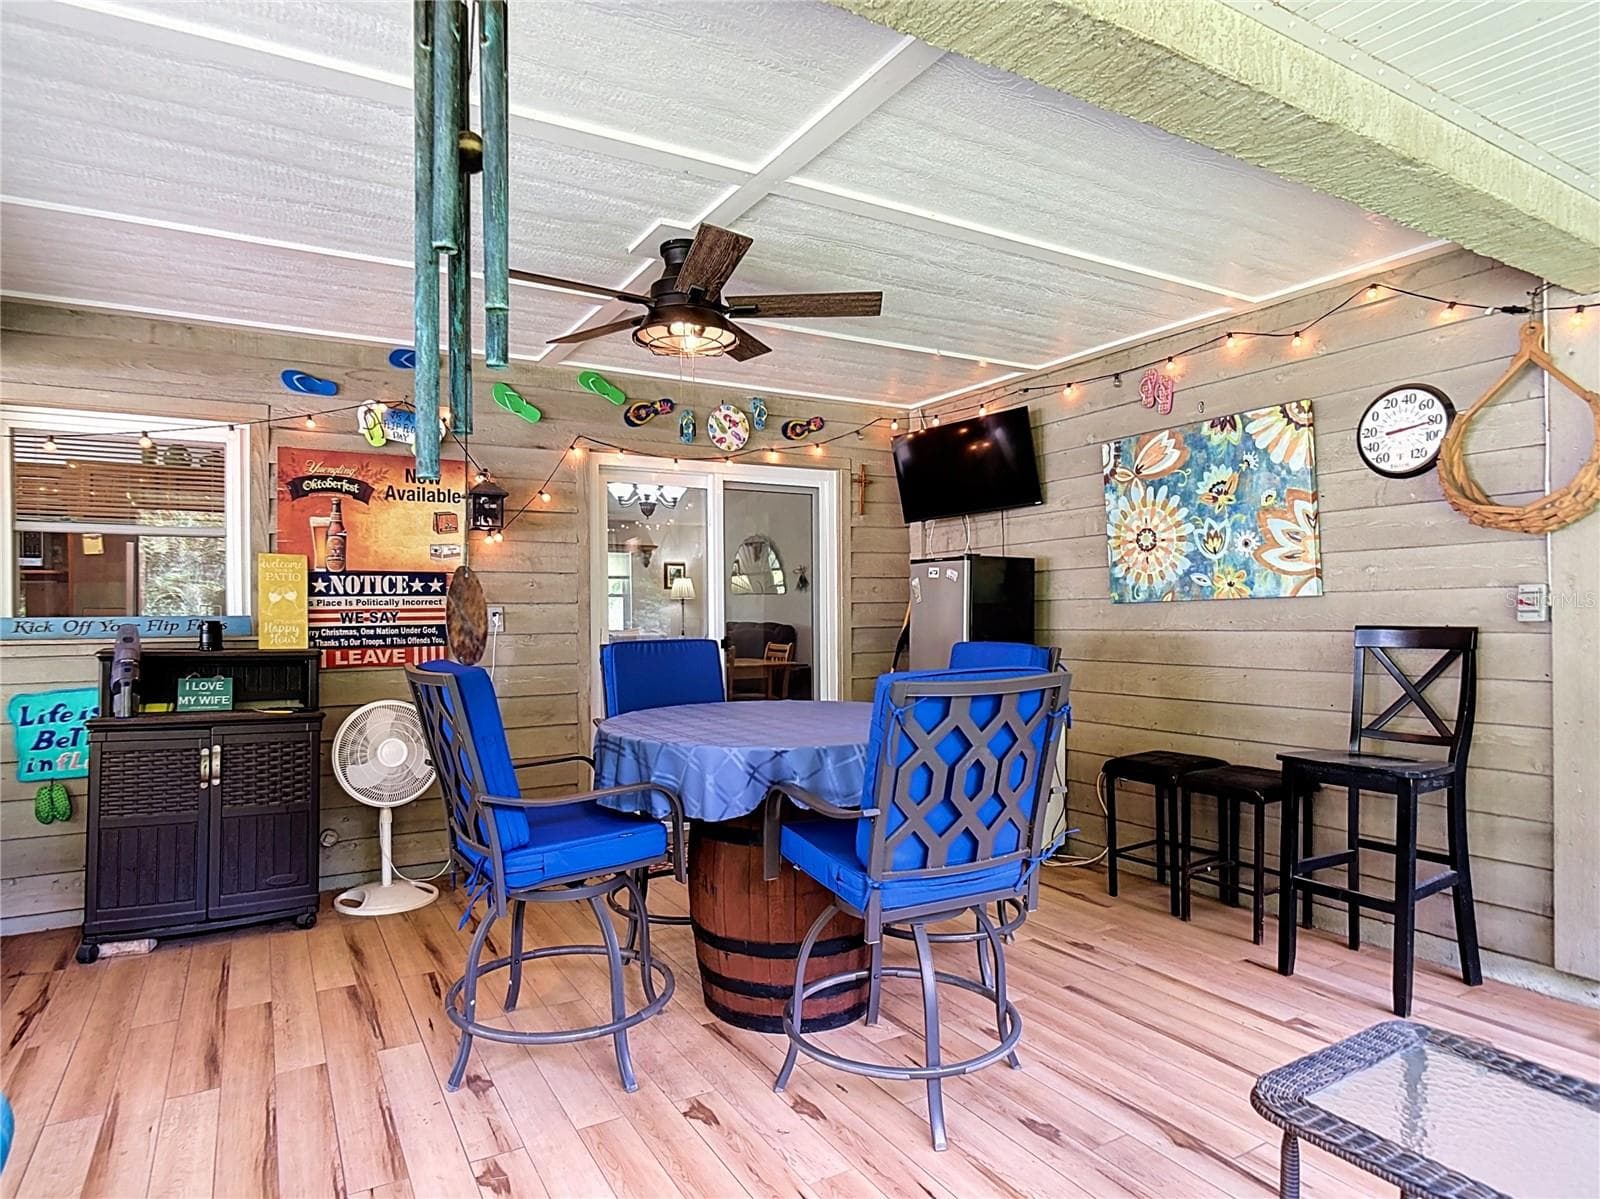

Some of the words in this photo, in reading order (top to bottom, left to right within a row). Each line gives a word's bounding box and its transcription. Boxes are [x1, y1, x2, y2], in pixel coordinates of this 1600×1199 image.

[1383, 398, 1398, 410] 20
[1401, 393, 1417, 405] 40
[1419, 399, 1435, 411] 60
[1372, 411, 1379, 422] 0
[1428, 413, 1443, 426] 80
[1371, 452, 1390, 464] -60
[1411, 447, 1428, 459] 120
[305, 460, 358, 476] Yuengling
[302, 477, 360, 494] Oktoberfest
[385, 485, 462, 504] Available
[262, 558, 303, 569] Welcome
[265, 572, 301, 582] PATIO
[328, 575, 409, 595] NOTICE
[316, 599, 342, 607] Place
[345, 599, 353, 607] Is
[356, 598, 400, 607] Politically
[402, 598, 442, 606] Incorrect
[341, 612, 364, 624] WE
[369, 611, 399, 623] SAY
[13, 621, 53, 634] Kick
[63, 620, 92, 635] Off
[147, 619, 180, 636] Flip
[264, 622, 300, 637] Happy
[321, 628, 359, 637] Christmas,
[361, 627, 374, 635] One
[376, 627, 399, 636] Nation
[400, 626, 420, 634] Under
[422, 626, 438, 634] God,
[270, 633, 298, 646] Hour
[315, 639, 339, 647] Thanks
[362, 638, 385, 647] Troops.
[393, 637, 406, 645] This
[407, 636, 431, 645] Offends
[335, 650, 406, 665] LEAVE
[192, 682, 224, 690] LOVE
[179, 696, 197, 704] MY
[199, 696, 230, 704] WIFE
[19, 702, 74, 727] Life
